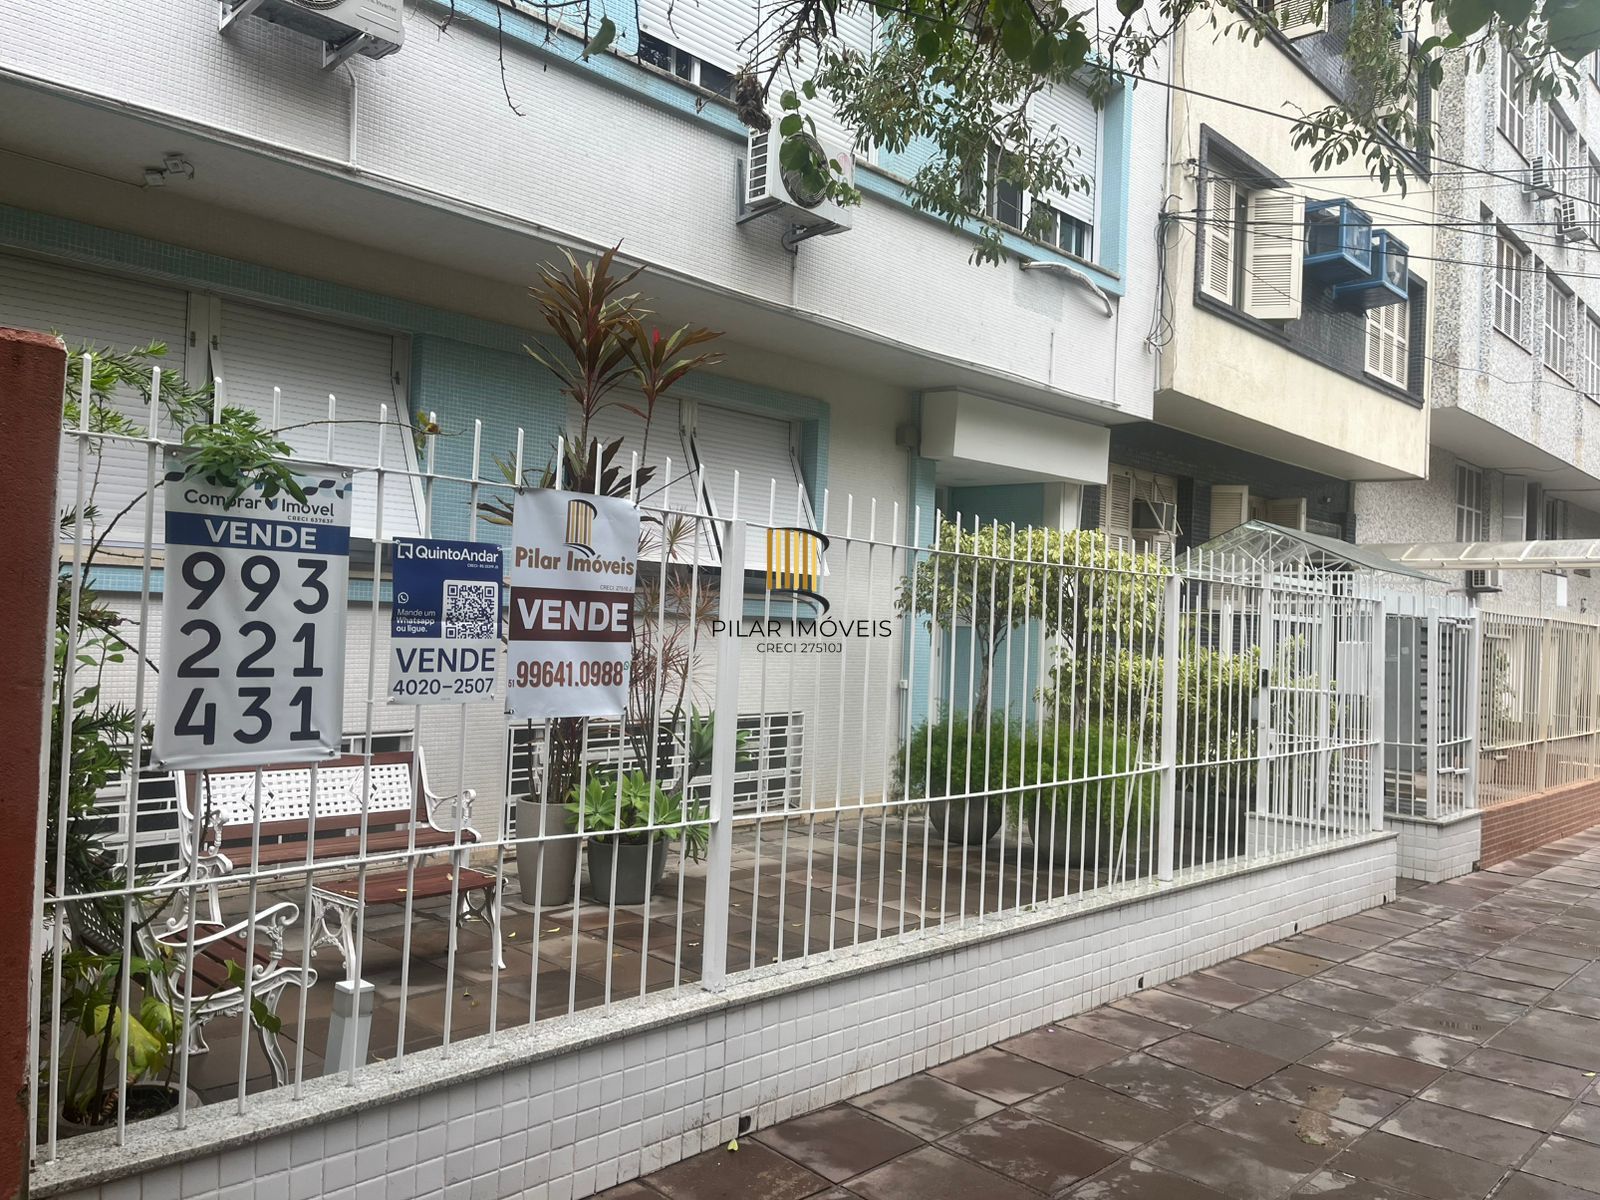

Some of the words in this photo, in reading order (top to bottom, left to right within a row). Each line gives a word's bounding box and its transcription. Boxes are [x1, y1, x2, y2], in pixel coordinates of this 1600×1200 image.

[204, 519, 317, 549] VENDE
[415, 545, 499, 563] QuintoAndar
[515, 546, 561, 570] Pilar
[566, 550, 635, 576] Imóveis
[182, 552, 329, 614] 993
[397, 608, 423, 616] Mande
[517, 598, 629, 632] VENDE
[177, 619, 324, 679] 221
[396, 648, 496, 673] VENDE
[393, 678, 494, 695] 4020-2507
[516, 661, 624, 688] 99641.0988
[174, 686, 321, 746] 431
